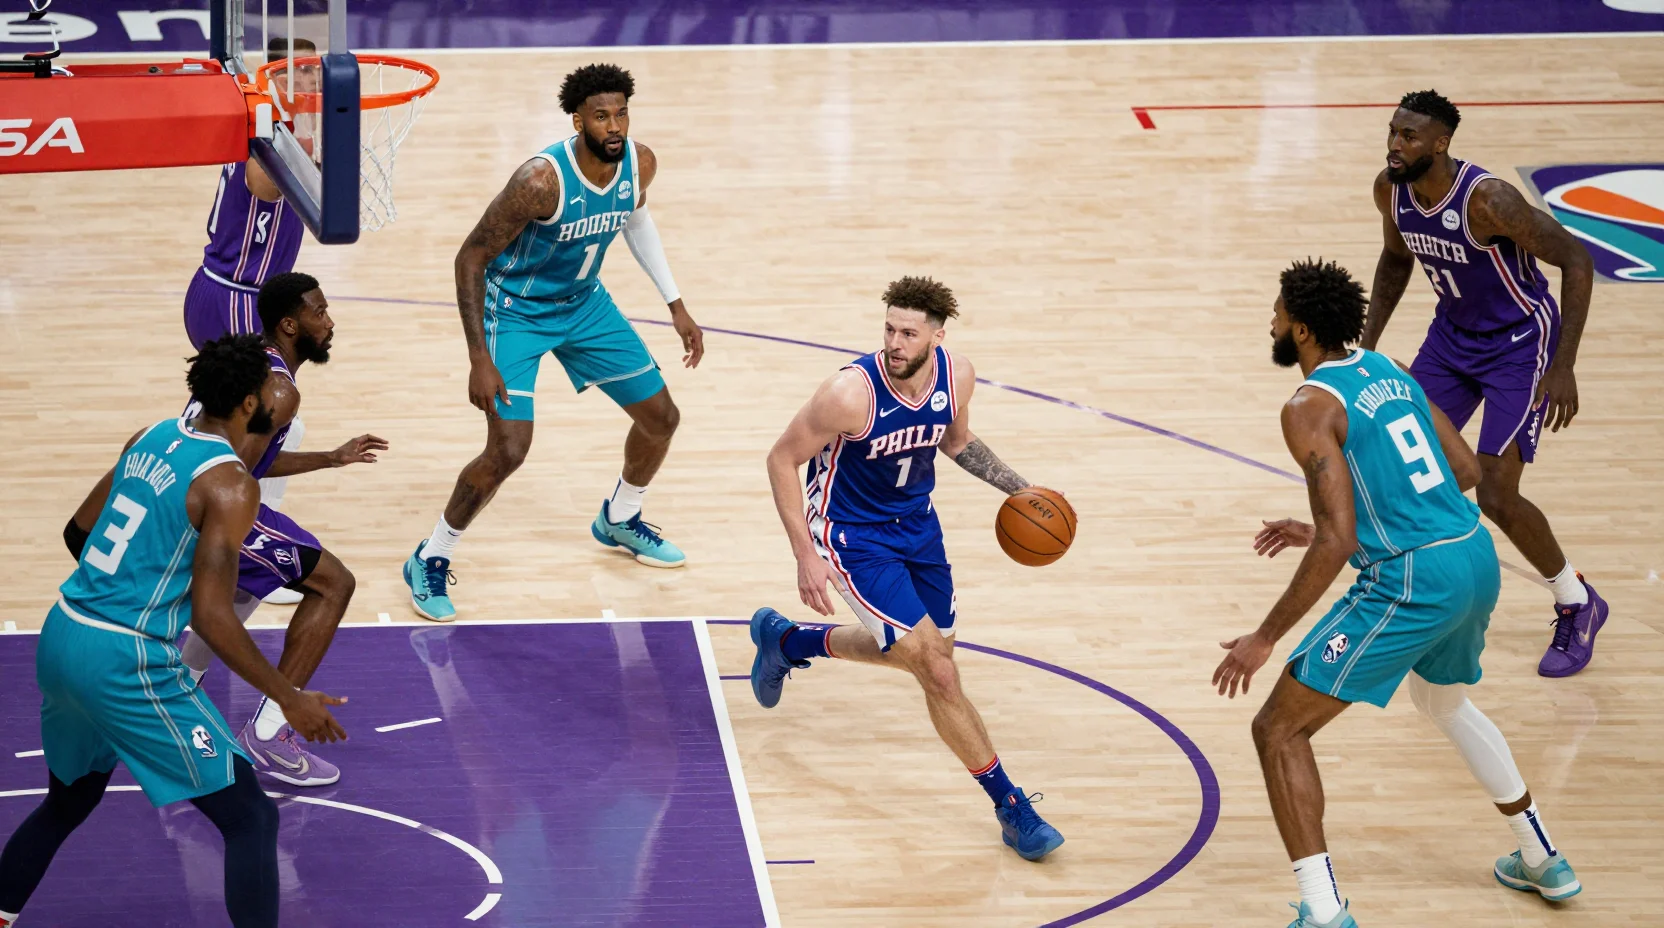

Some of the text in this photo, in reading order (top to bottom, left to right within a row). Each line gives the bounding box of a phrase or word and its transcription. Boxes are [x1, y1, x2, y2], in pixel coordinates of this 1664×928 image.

[0, 117, 85, 157] SA
[575, 243, 600, 280] 1
[895, 456, 913, 488] 1
[1385, 412, 1445, 494] 9
[84, 493, 148, 576] 3
